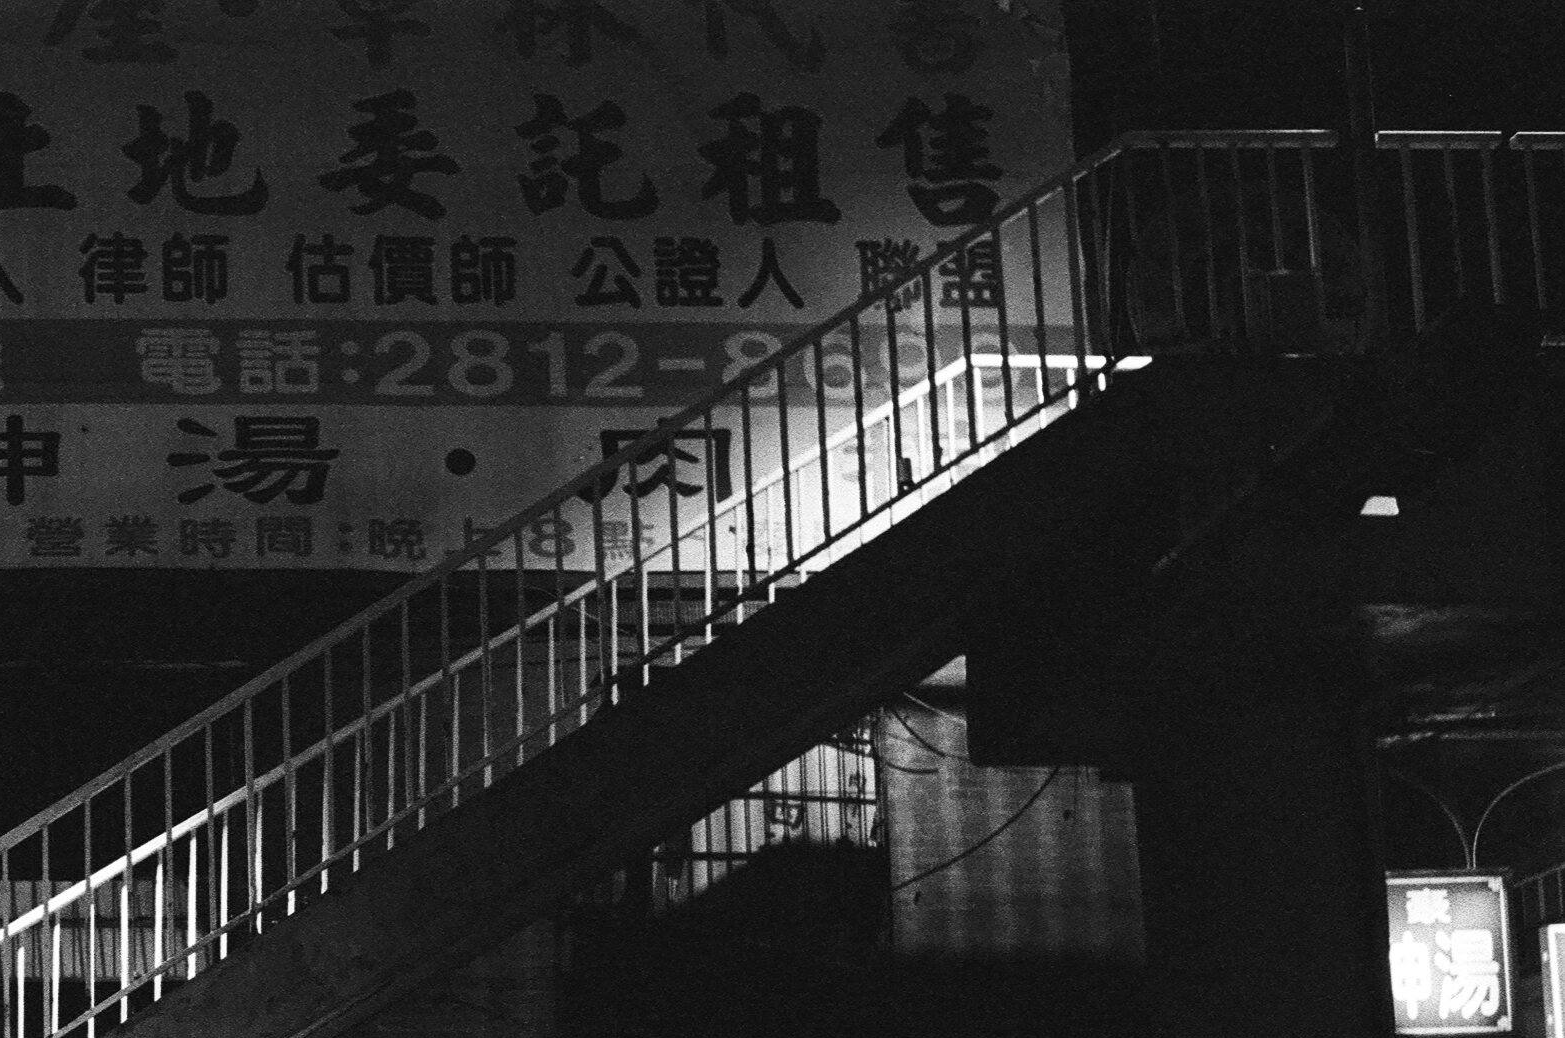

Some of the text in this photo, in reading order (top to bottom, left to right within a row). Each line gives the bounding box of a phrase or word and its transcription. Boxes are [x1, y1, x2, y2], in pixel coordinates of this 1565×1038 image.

[78, 232, 230, 306] 律師
[285, 232, 518, 307] 估價師
[571, 235, 805, 310] 公證人
